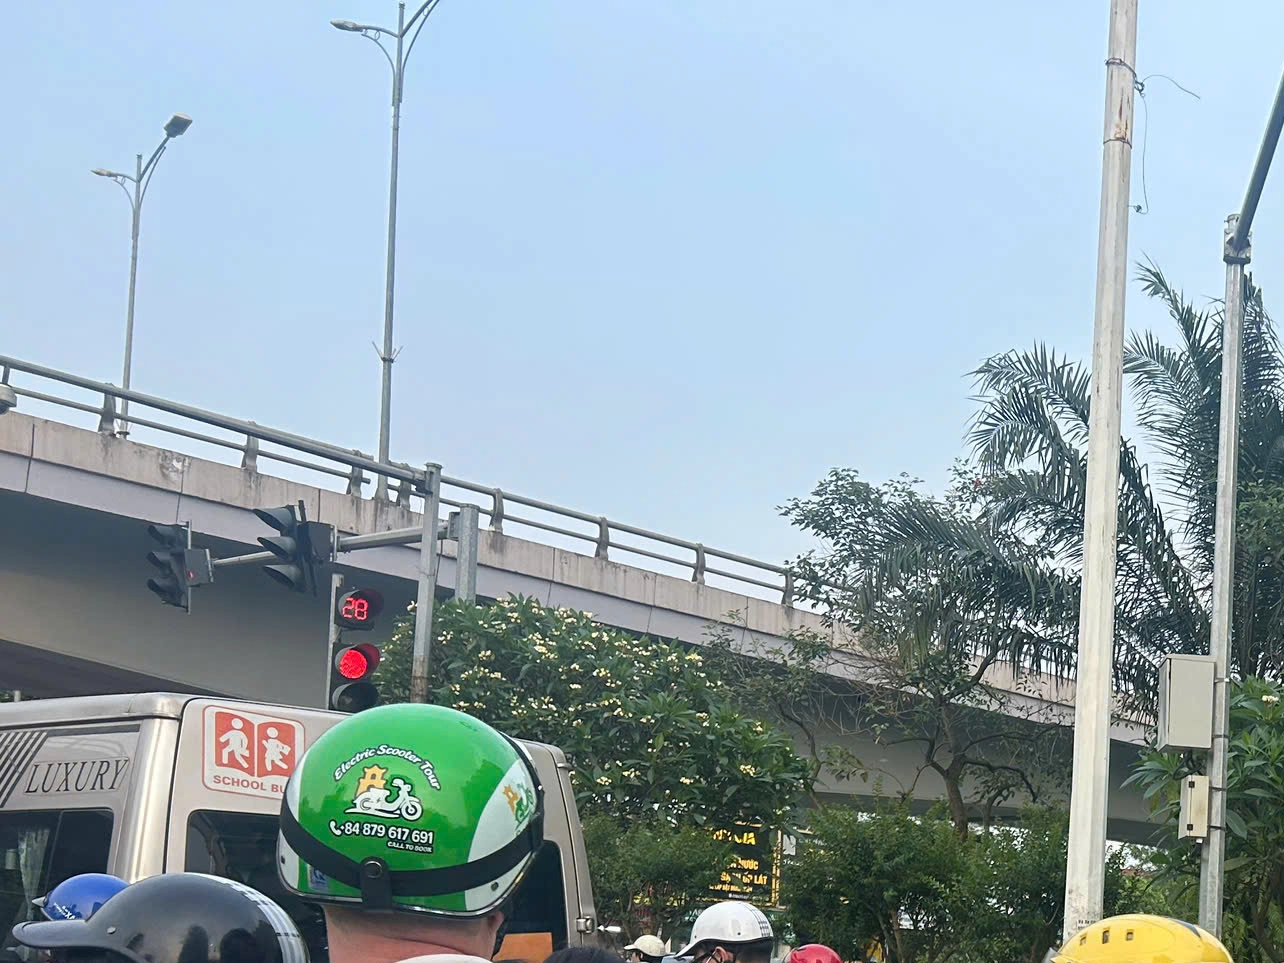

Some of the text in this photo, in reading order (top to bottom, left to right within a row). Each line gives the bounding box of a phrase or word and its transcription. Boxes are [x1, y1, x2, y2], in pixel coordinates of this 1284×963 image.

[342, 597, 369, 620] 28
[25, 758, 129, 794] LUXURY
[334, 744, 441, 790] Electric Scooter Tour
[213, 774, 285, 794] SCHOOL BU
[362, 823, 386, 837] 879
[388, 826, 409, 841] 617
[411, 830, 434, 845] 691
[387, 841, 433, 853] CALL TO BOOK
